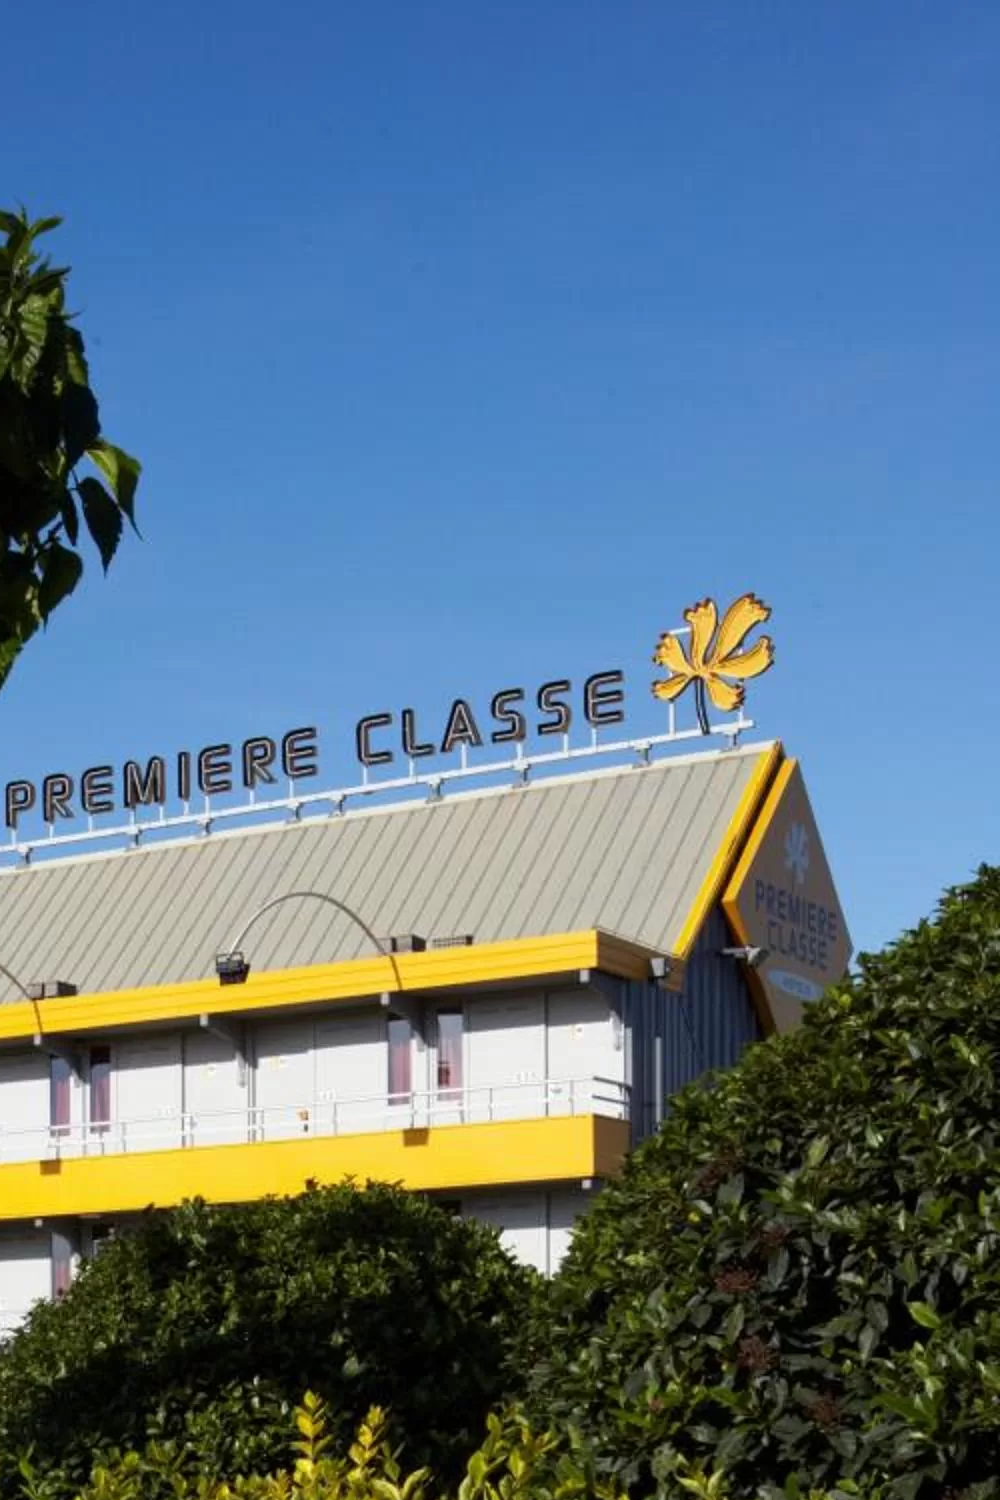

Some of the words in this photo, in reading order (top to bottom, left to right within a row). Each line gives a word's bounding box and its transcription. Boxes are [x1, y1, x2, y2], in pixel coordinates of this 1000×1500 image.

[5, 726, 318, 828] PREMIERE
[355, 669, 626, 766] CLASSE
[755, 880, 837, 941] PREMIERE
